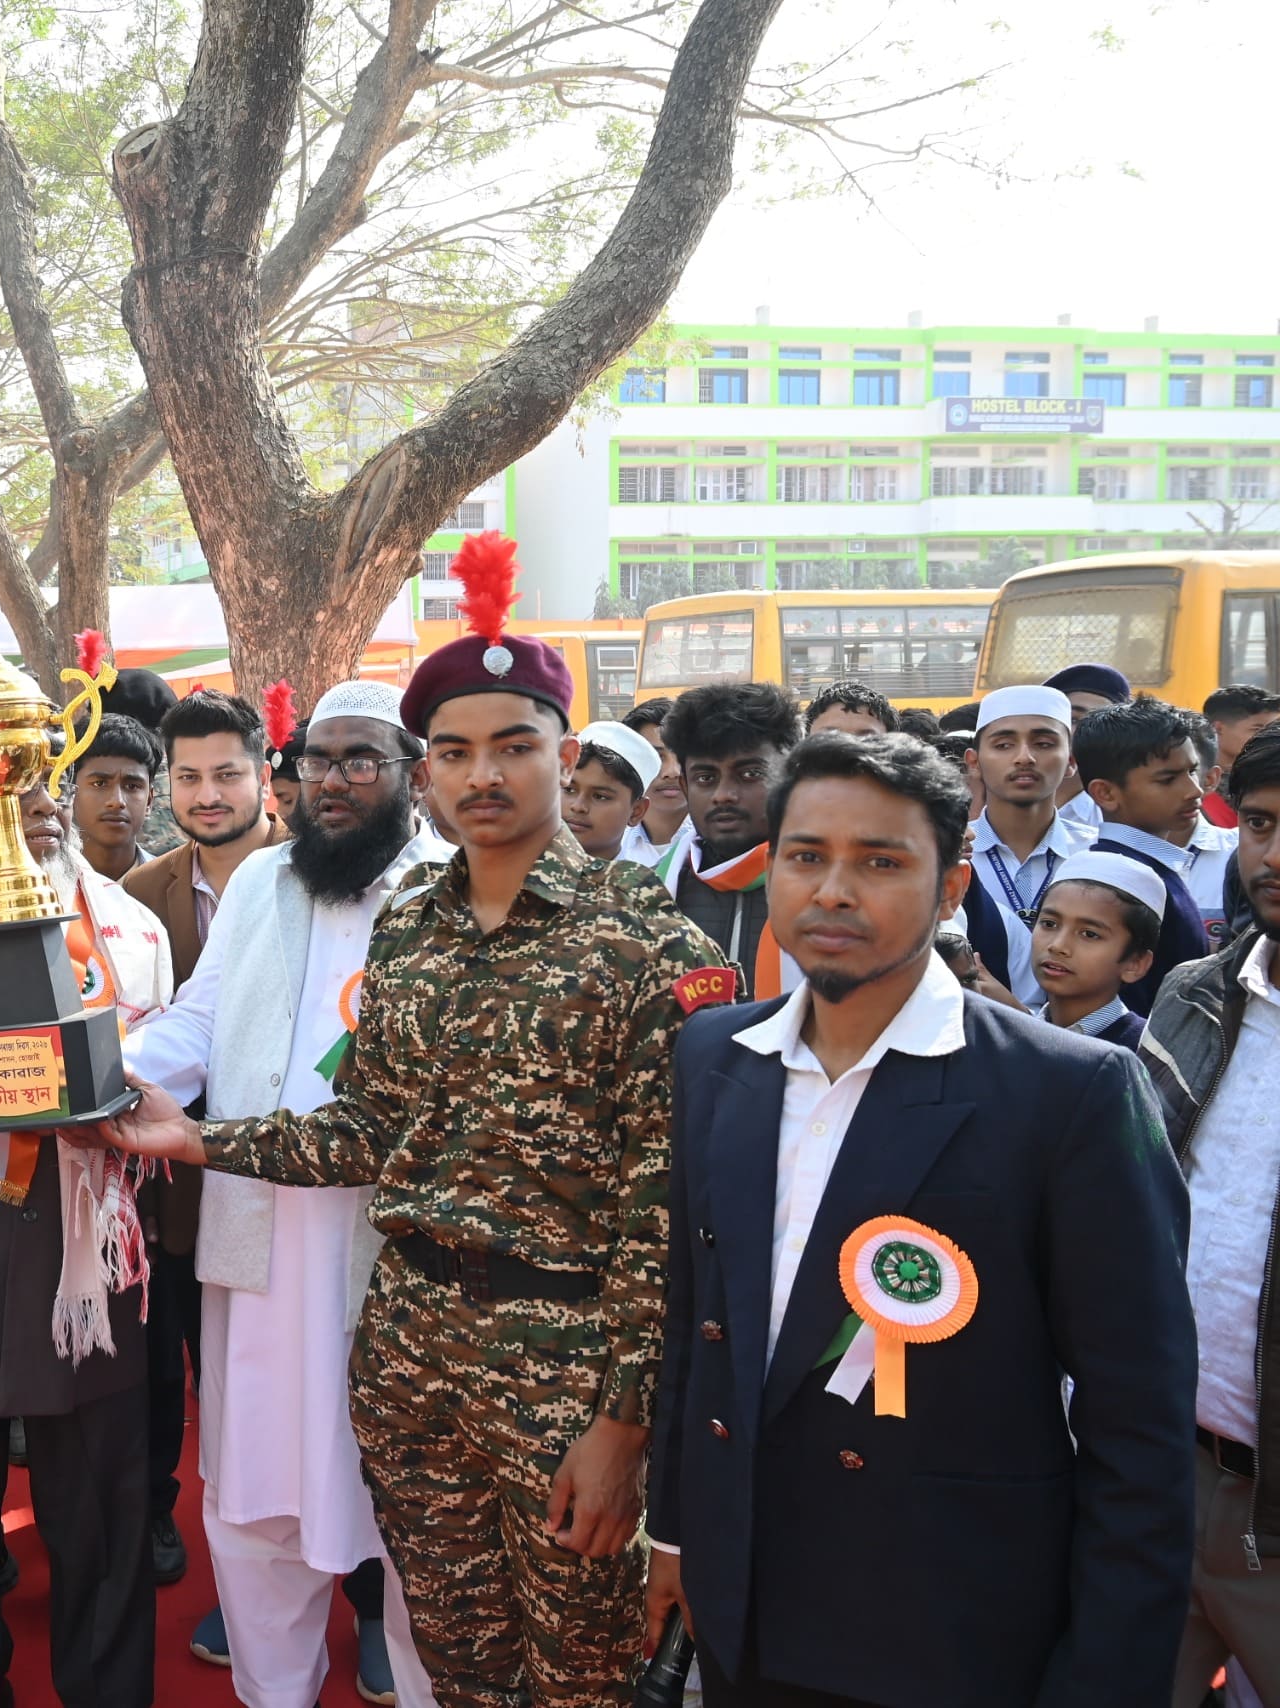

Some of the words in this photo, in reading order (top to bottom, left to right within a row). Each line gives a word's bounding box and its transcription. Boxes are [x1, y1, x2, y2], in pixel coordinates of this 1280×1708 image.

[972, 399, 1020, 413] HOSTEL
[1024, 399, 1066, 413] BLOCK
[683, 976, 723, 1002] NCC
[20, 1085, 51, 1106] স্থান
